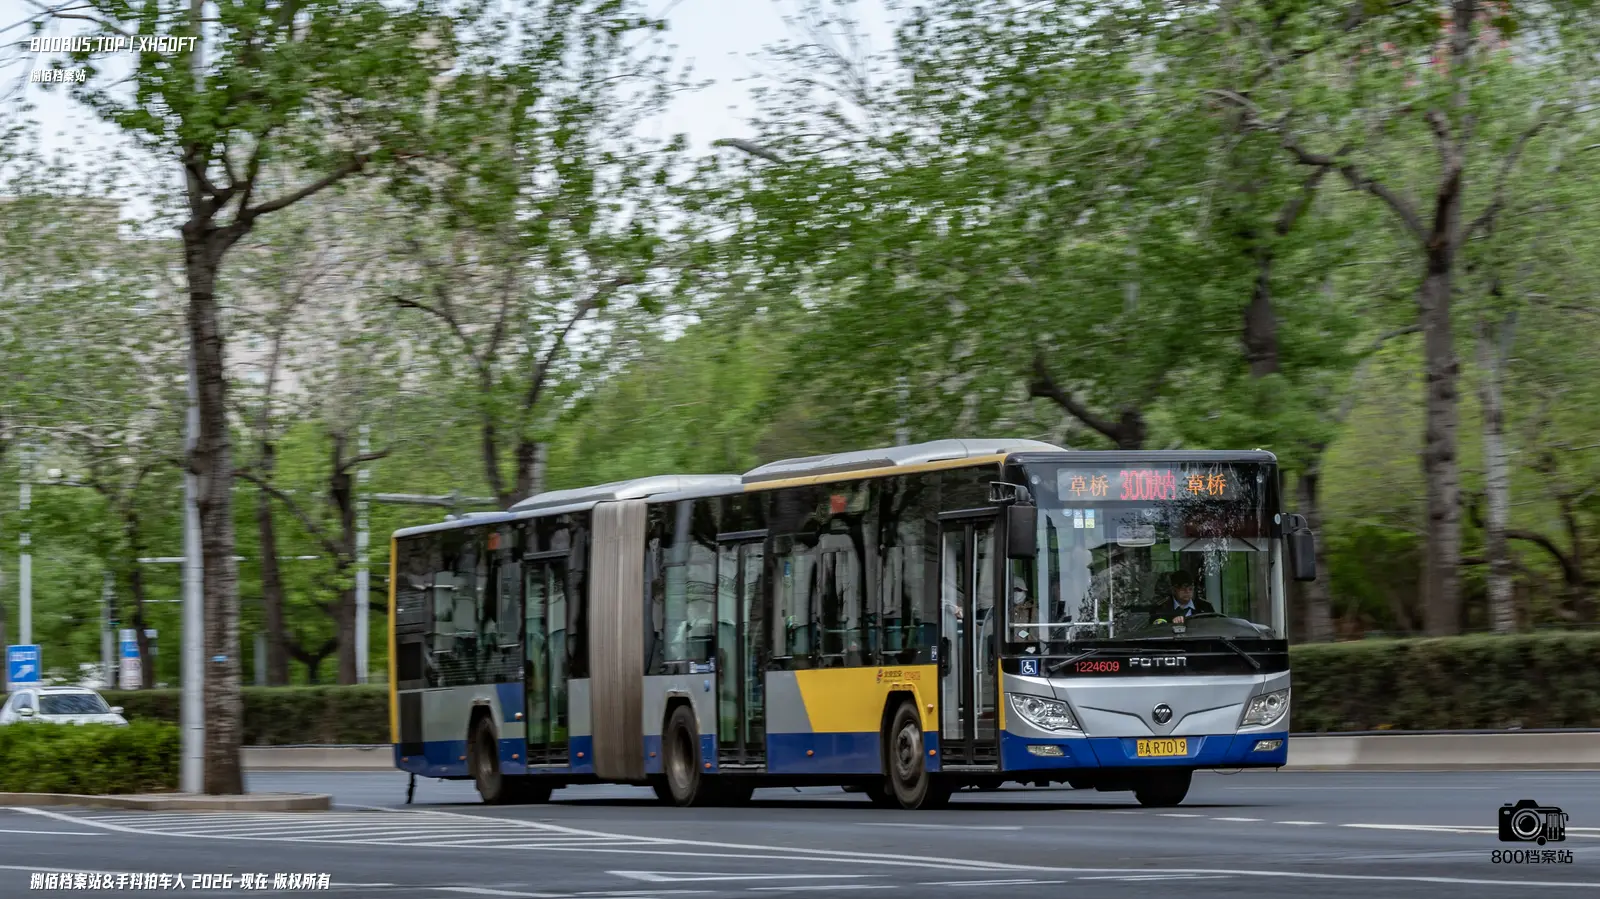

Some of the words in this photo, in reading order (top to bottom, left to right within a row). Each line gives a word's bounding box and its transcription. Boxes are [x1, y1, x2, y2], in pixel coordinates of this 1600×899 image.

[1068, 474, 1111, 497] 草桥
[1186, 473, 1228, 496] 草桥
[1074, 661, 1120, 673] 1224609
[1129, 656, 1187, 667] FOTON
